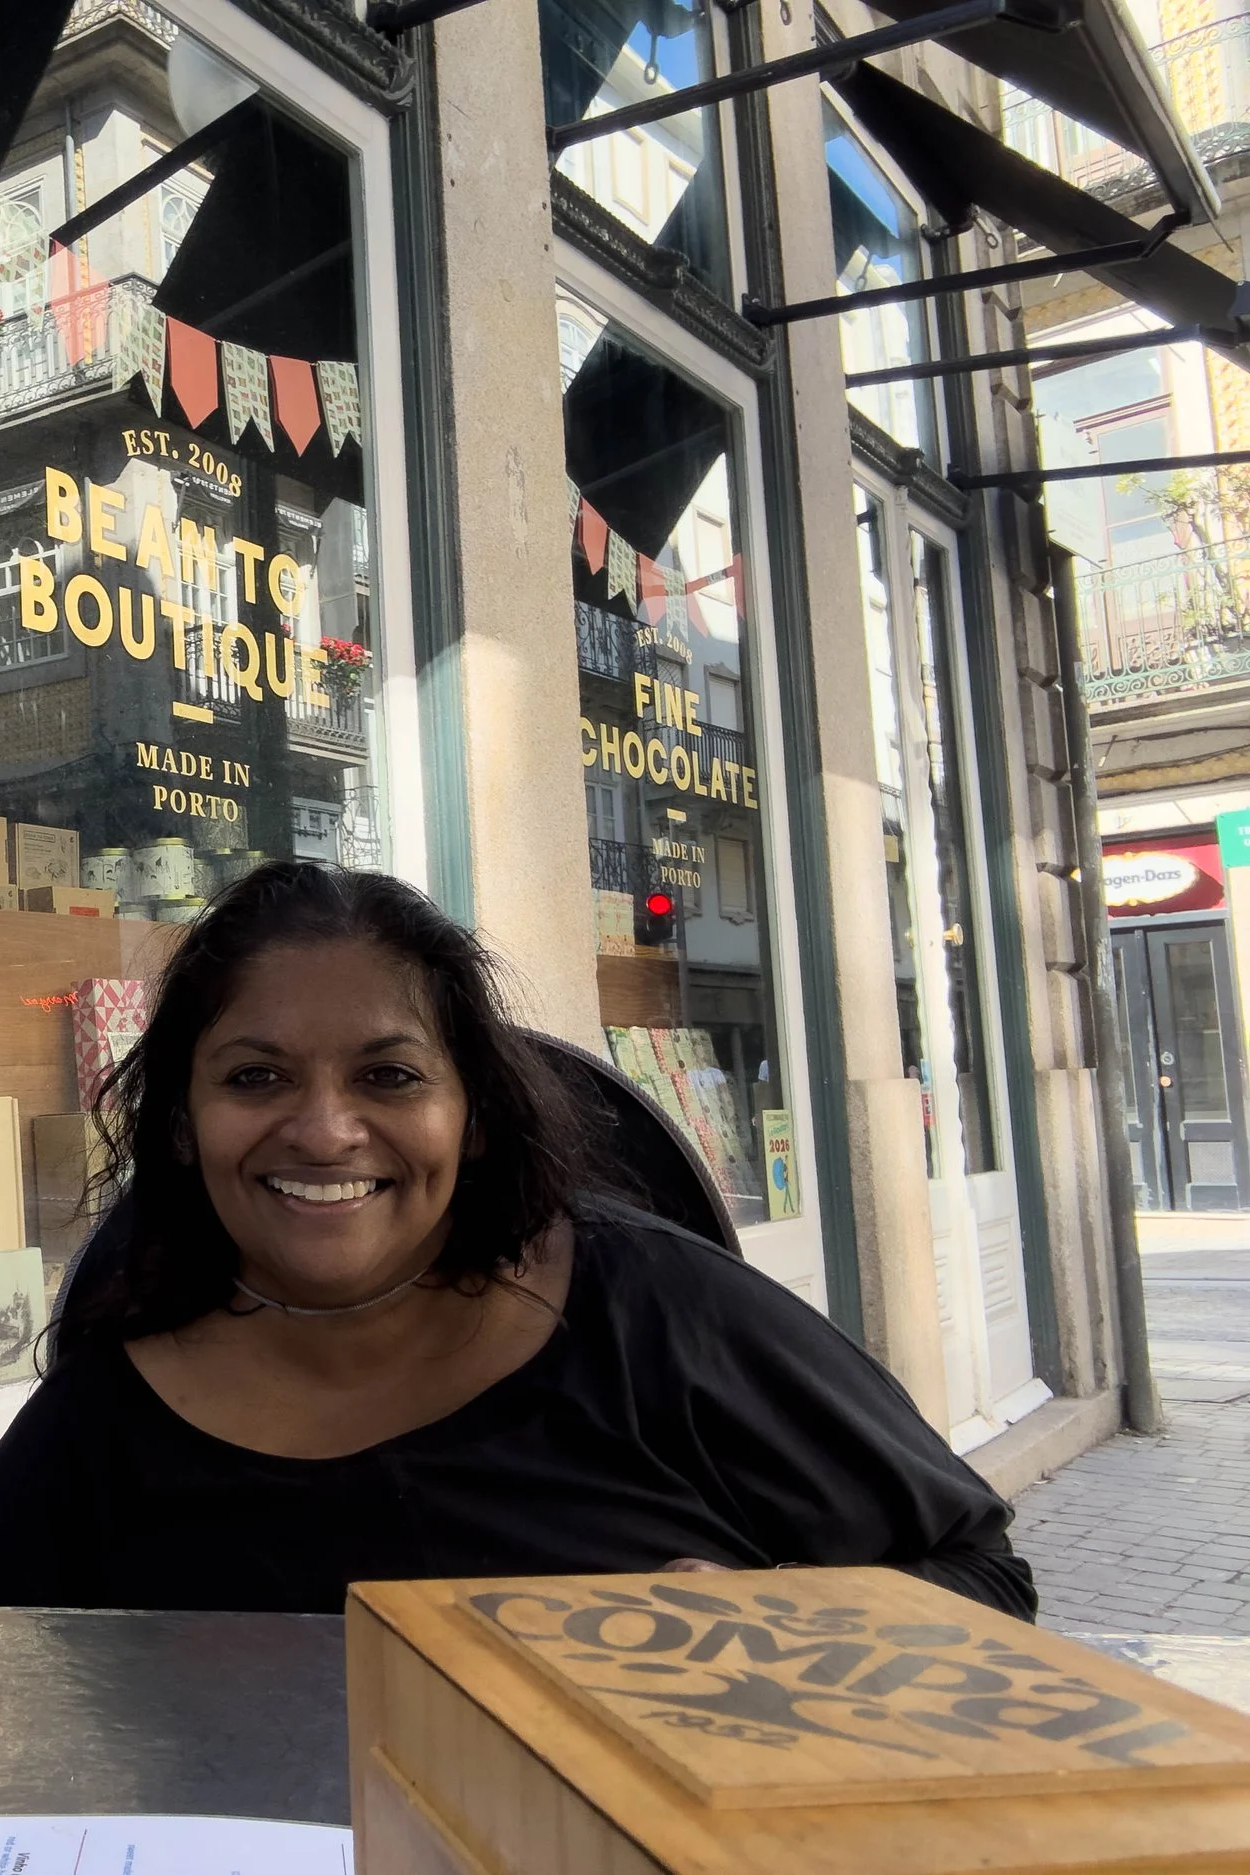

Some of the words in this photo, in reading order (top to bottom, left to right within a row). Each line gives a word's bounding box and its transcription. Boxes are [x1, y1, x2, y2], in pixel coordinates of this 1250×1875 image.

[122, 429, 179, 460] EST.
[189, 444, 243, 498] 2008
[45, 466, 217, 590] BEAN
[232, 536, 303, 617] TO
[20, 556, 330, 709] BOUTIQUE
[637, 626, 663, 648] EST.
[667, 633, 694, 665] 2008
[634, 671, 702, 737] FINE
[136, 742, 214, 781] MADE
[223, 761, 250, 788] IN
[580, 717, 758, 810] CHOCOLATE
[153, 785, 239, 823] PORTO
[652, 838, 689, 862] MADE
[693, 846, 706, 864] IN
[661, 866, 702, 889] PORTO
[1104, 869, 1182, 890] agen-Dazs
